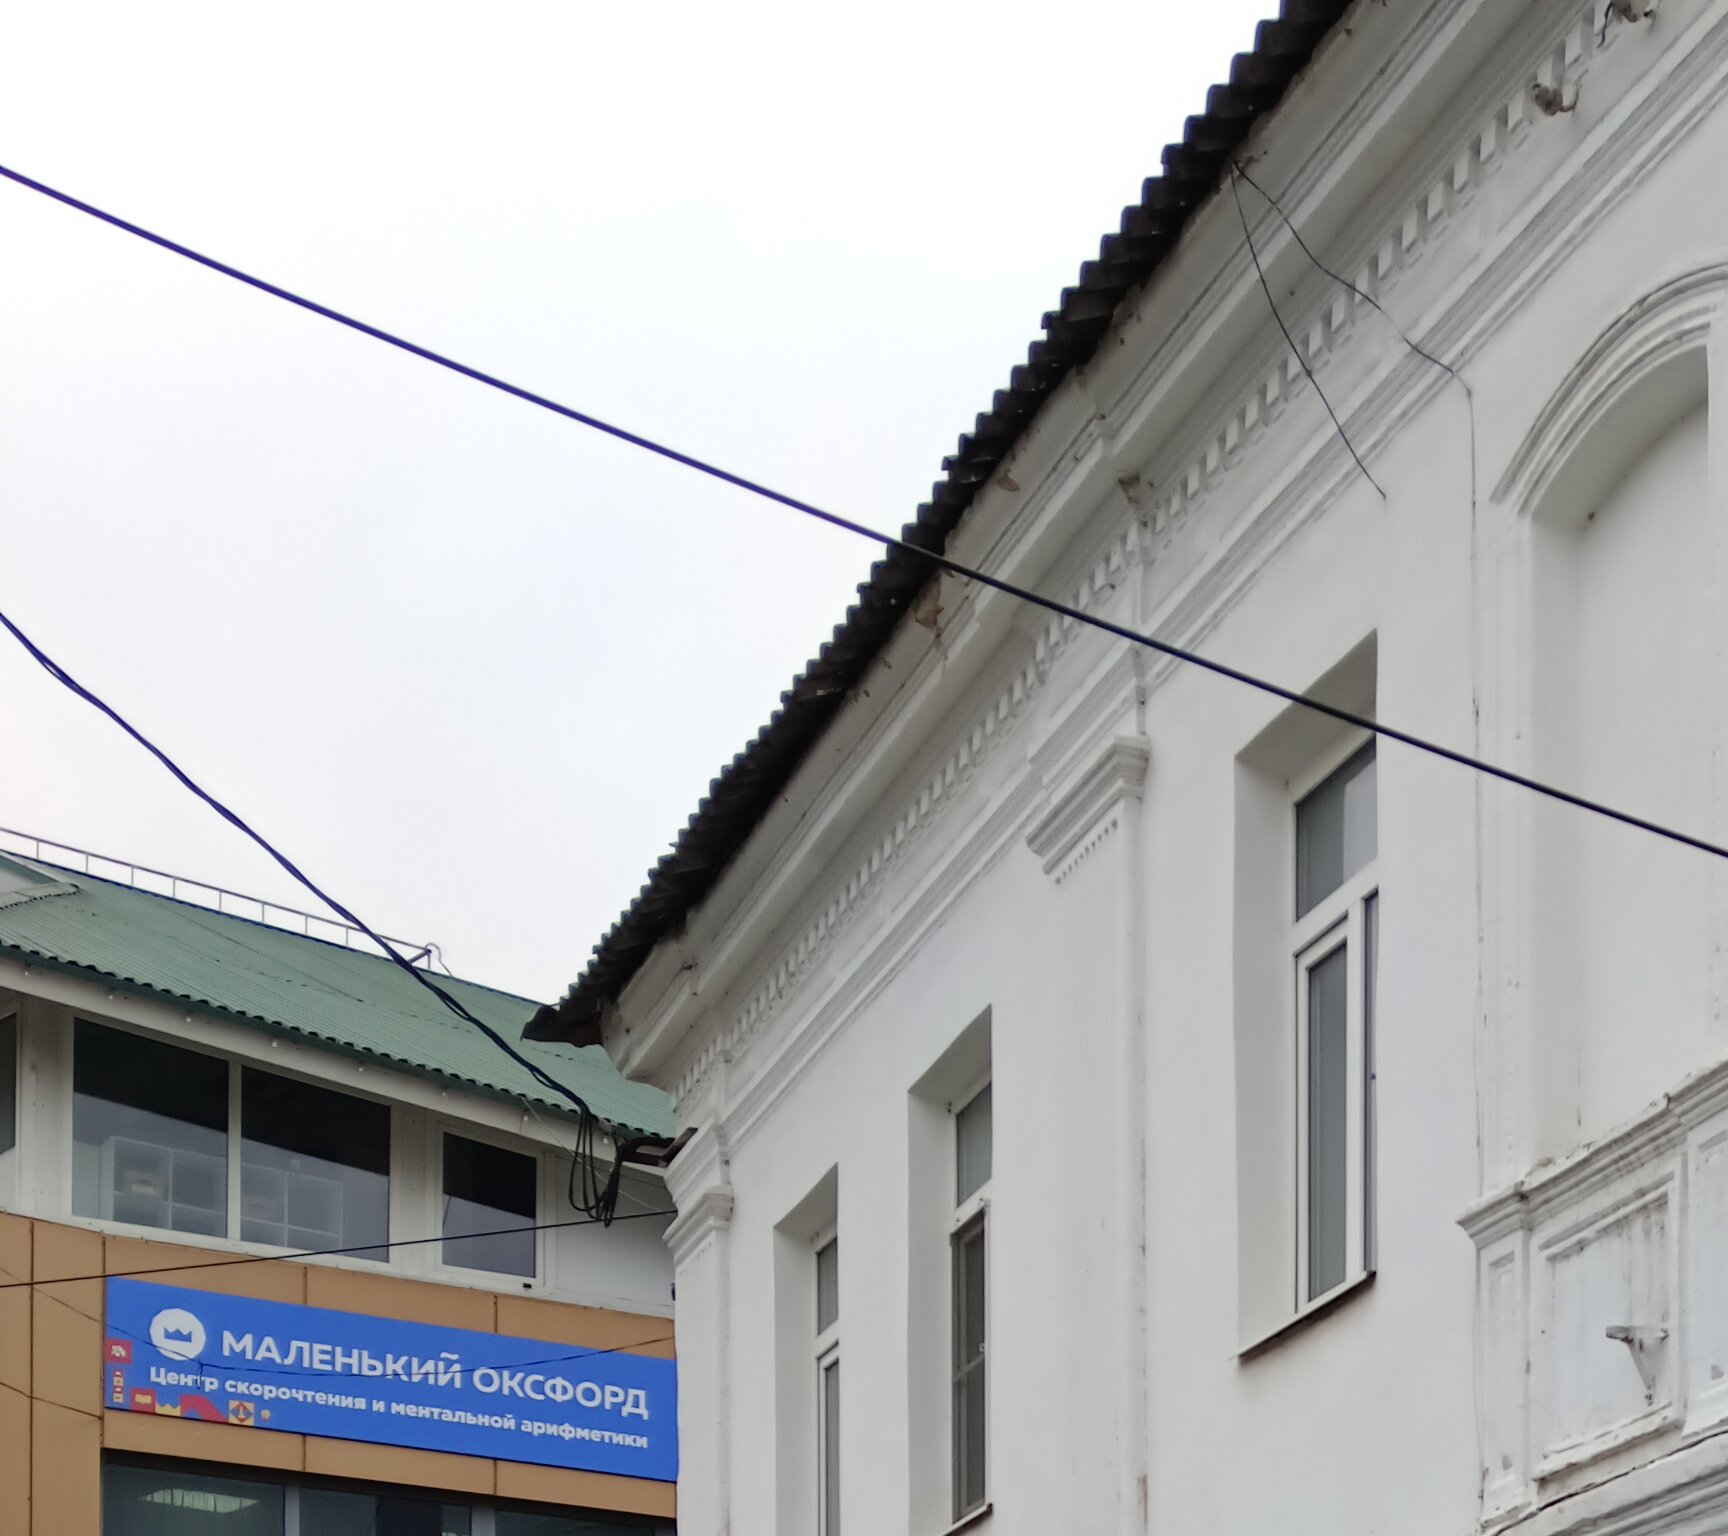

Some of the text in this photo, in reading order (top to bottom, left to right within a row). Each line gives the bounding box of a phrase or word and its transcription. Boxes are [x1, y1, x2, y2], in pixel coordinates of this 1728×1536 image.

[150, 1366, 648, 1449] Центр скорочтения и ментальной арифметики
[222, 1330, 649, 1420] МАЛЕНЬКИЙ ОКСФОРД
